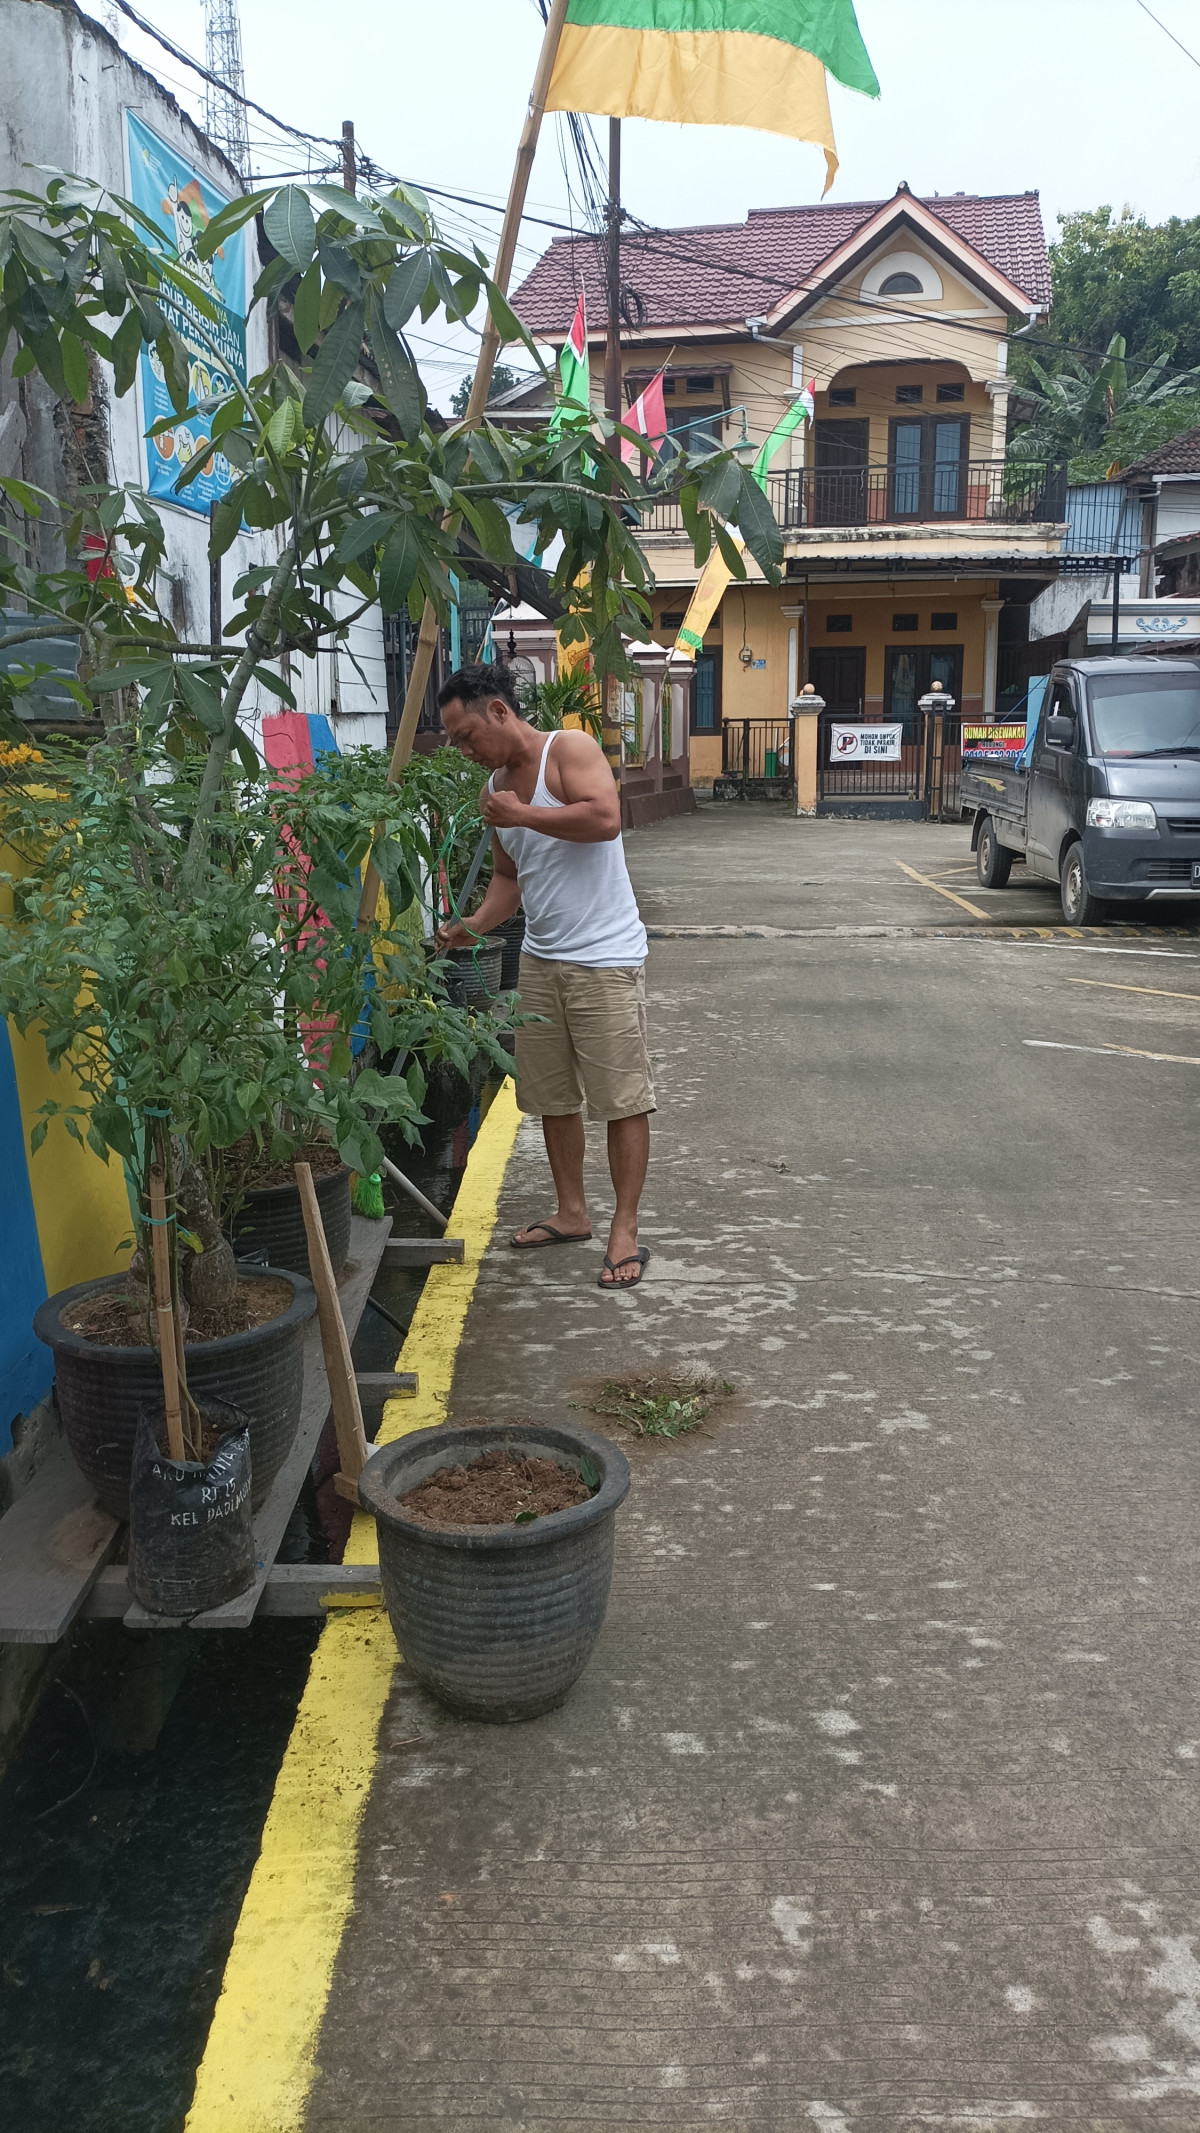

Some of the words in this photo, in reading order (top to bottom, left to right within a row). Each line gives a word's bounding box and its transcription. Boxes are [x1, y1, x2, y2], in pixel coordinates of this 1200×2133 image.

[159, 281, 184, 306] IDUP
[220, 323, 240, 350] DAN
[964, 727, 987, 739] RUMAH
[988, 726, 1025, 739] DISEWAKAN
[864, 745, 872, 754] DI
[873, 745, 888, 754] SINI
